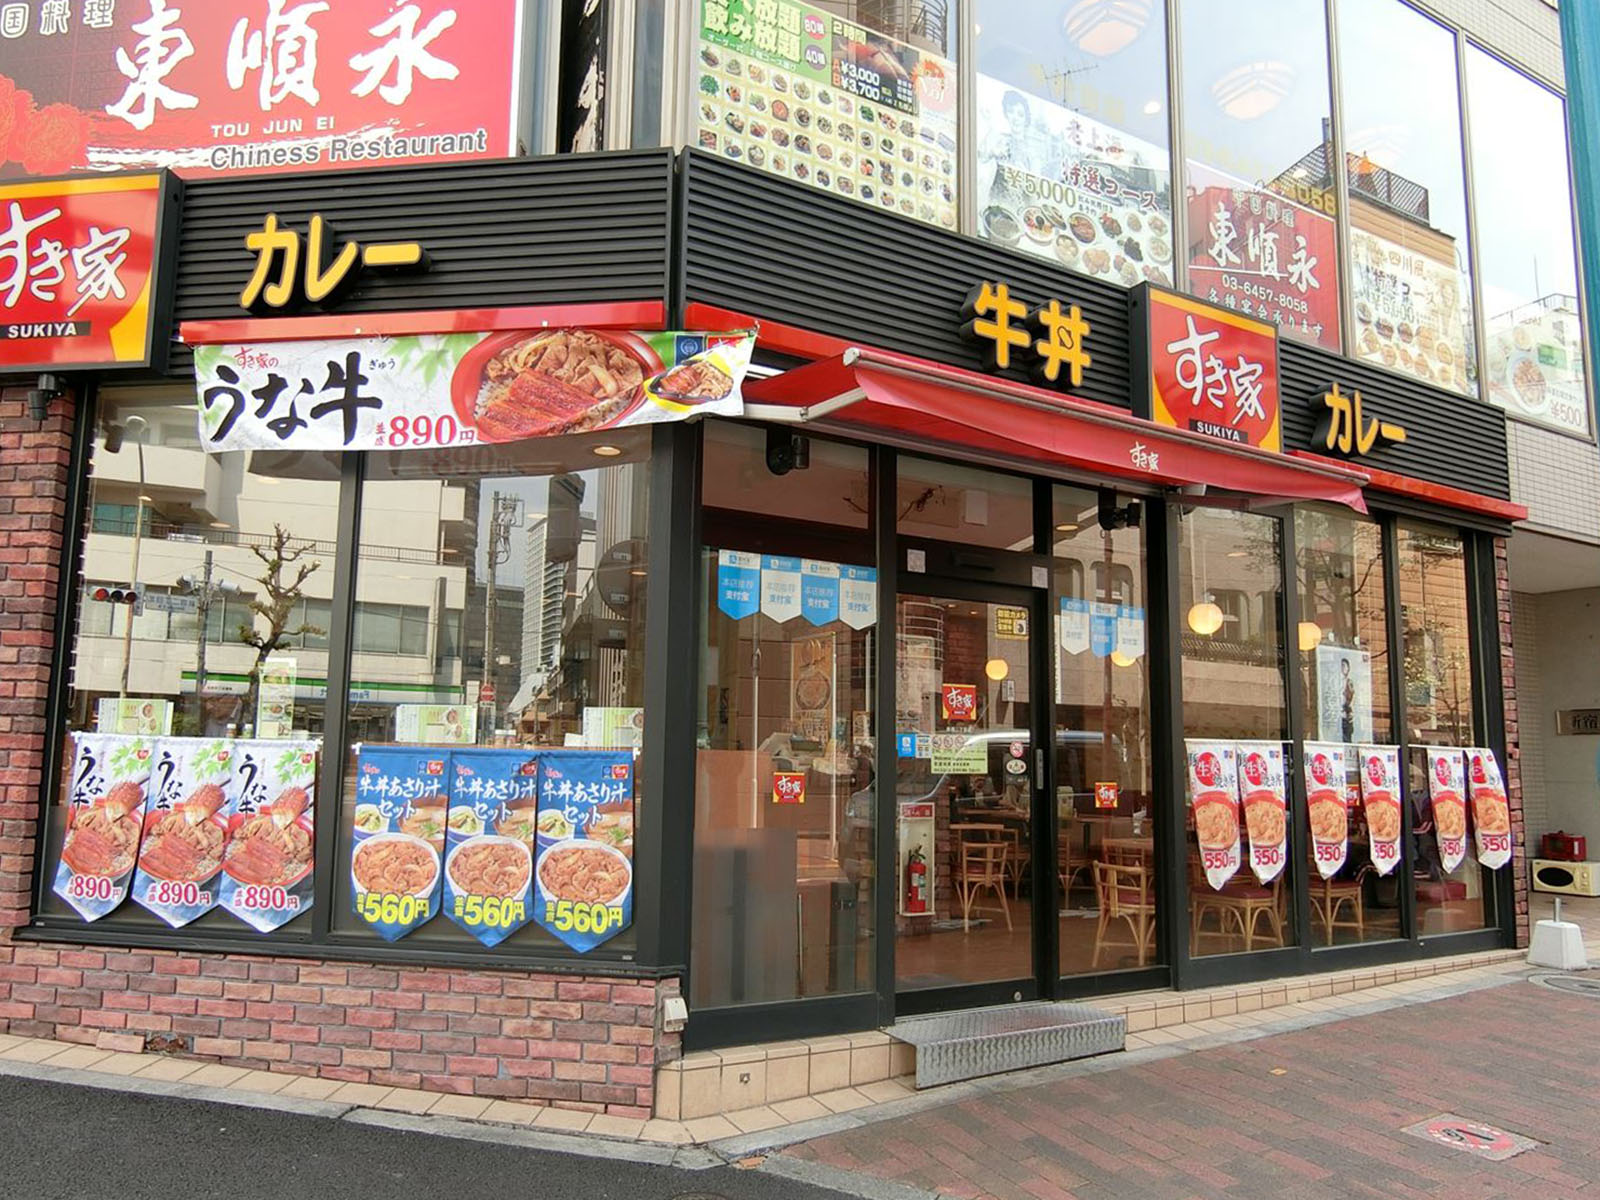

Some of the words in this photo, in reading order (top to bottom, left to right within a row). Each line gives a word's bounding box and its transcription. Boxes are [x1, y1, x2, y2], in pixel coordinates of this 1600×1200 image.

[704, 2, 802, 66] 飲み放題
[105, 0, 461, 131] 東順永
[840, 60, 881, 87] ¥3,000
[840, 76, 882, 101] ¥3,700
[211, 124, 250, 138] TOU
[263, 120, 303, 134] JUN
[316, 116, 335, 130] EI
[208, 138, 324, 169] Chiness
[328, 128, 487, 162] Restaurant
[1004, 167, 1077, 209] ¥5,000
[1062, 160, 1160, 212] 特選コース
[0, 201, 131, 316] すき家
[239, 212, 423, 309] カレー
[1207, 201, 1320, 293] 東順永
[1221, 274, 1309, 314] 03-6457-8058
[8, 321, 77, 339] SUKIYA
[1208, 288, 1323, 340] 各種宴会承ります
[973, 280, 1092, 387] 牛丼
[234, 346, 279, 370] すき家の
[367, 358, 396, 372] ぎゅう
[1166, 314, 1266, 425] すき家
[203, 351, 383, 447] うな牛
[1550, 401, 1582, 428] ¥500
[388, 415, 476, 447] 890円
[1196, 421, 1241, 442] SUKIYA
[1324, 381, 1408, 456] カレー
[1129, 441, 1160, 473] すき家
[946, 687, 973, 711] すき家
[73, 746, 105, 812] うな牛
[156, 750, 184, 814] うな牛
[237, 753, 267, 819] うな牛
[358, 776, 442, 800] 牛丼あさり汁
[453, 777, 538, 801] 牛丼あさり汁
[542, 779, 628, 806] 牛丼あさり汁
[378, 799, 417, 821] セット
[473, 801, 513, 823] セット
[563, 805, 603, 827] セット
[74, 875, 121, 900] 890円
[157, 881, 211, 906] 890円
[244, 887, 299, 910] 890円
[364, 893, 430, 926] 560円
[463, 895, 526, 929] 560円
[555, 900, 623, 935] 560円
